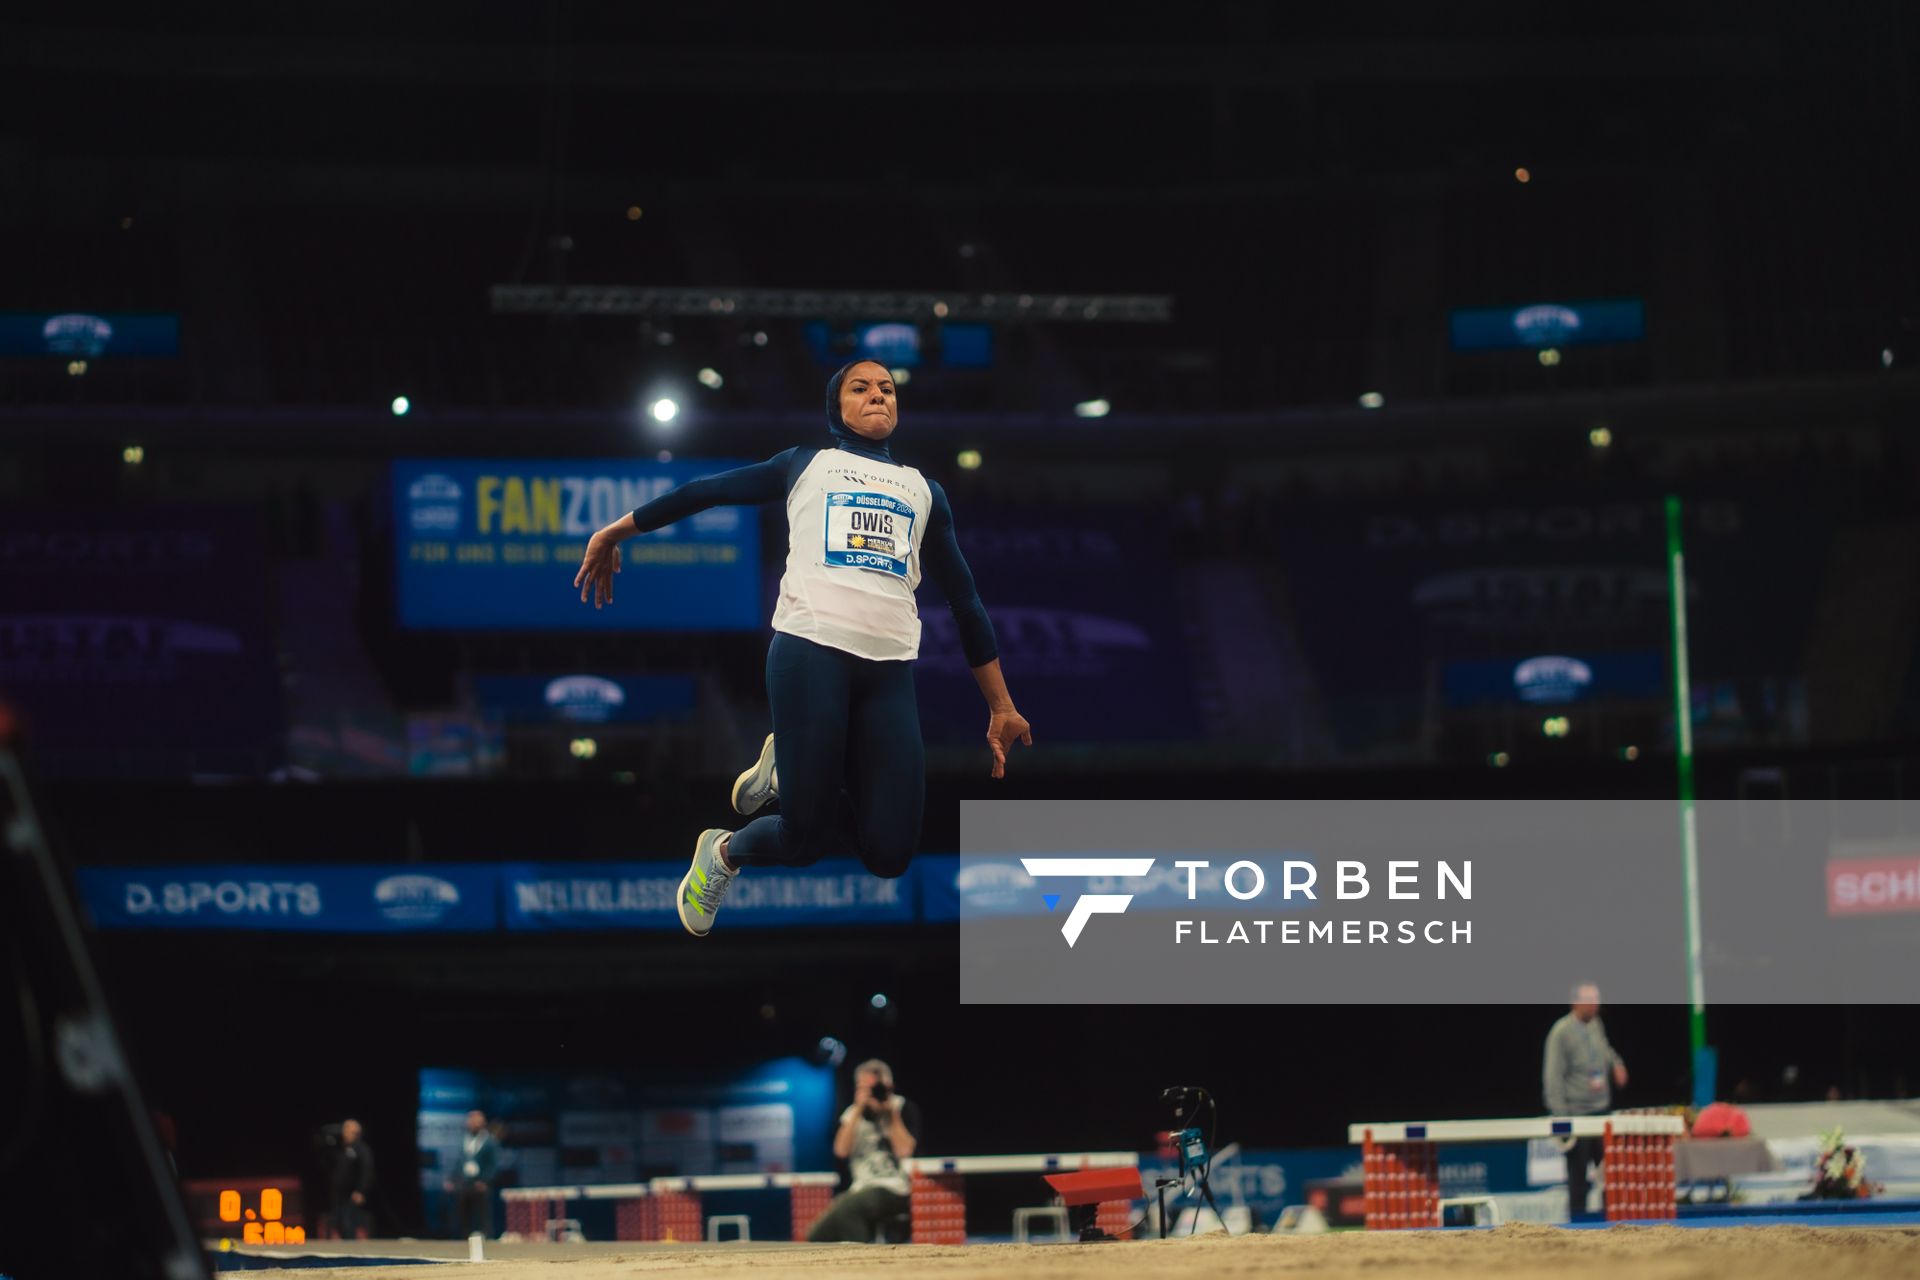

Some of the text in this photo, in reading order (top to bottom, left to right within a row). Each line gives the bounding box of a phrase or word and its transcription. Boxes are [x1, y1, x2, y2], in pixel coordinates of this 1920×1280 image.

[827, 467, 857, 475] PUSH
[856, 495, 897, 510] DÜSSELDORF
[896, 503, 912, 514] 2024
[851, 511, 893, 535] OWIS
[846, 554, 893, 570] D.SPORTS
[126, 881, 320, 915] D.SPORTS
[1835, 870, 1920, 906] SCH
[219, 1188, 283, 1222] 0.0
